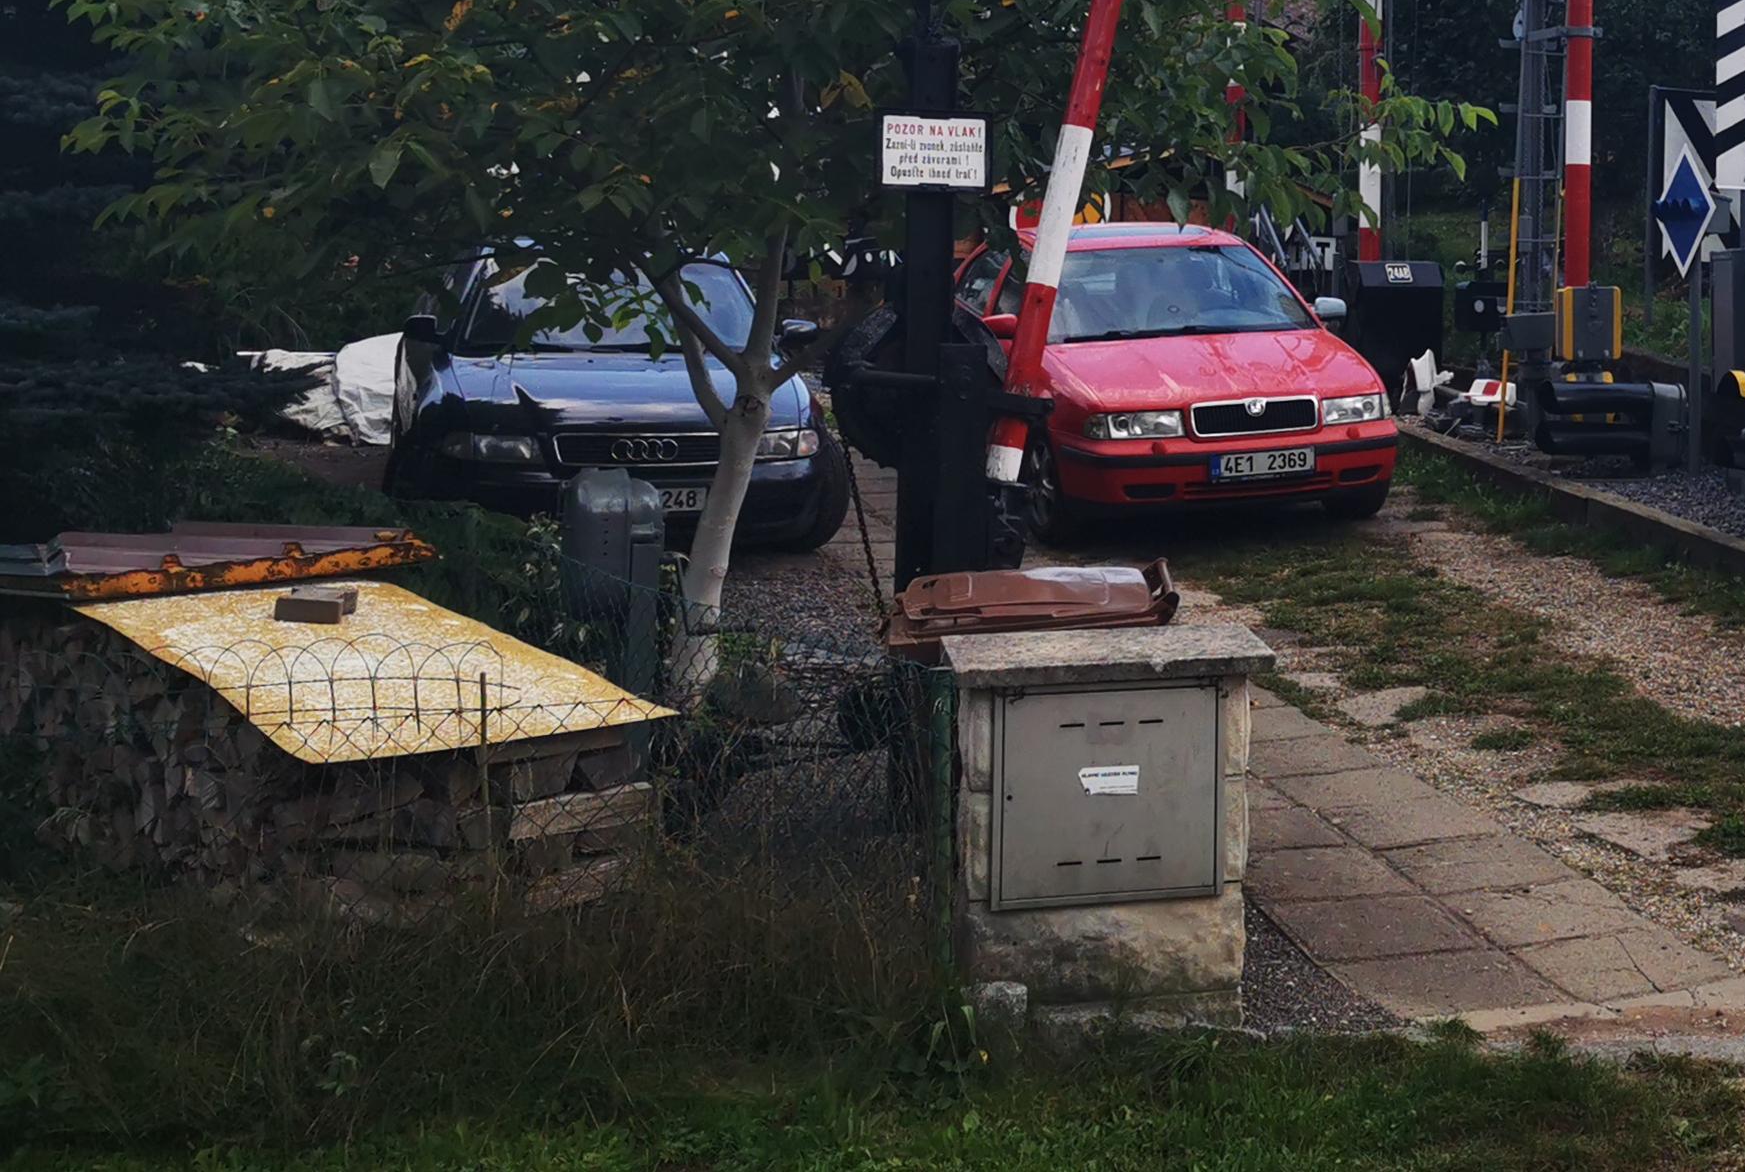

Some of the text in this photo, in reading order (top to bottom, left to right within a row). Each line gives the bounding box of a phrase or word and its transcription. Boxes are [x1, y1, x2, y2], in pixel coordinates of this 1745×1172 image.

[887, 123, 924, 135] POZOR
[929, 125, 944, 136] NA
[1224, 451, 1308, 474] 4E1 2369
[662, 490, 697, 509] 248
